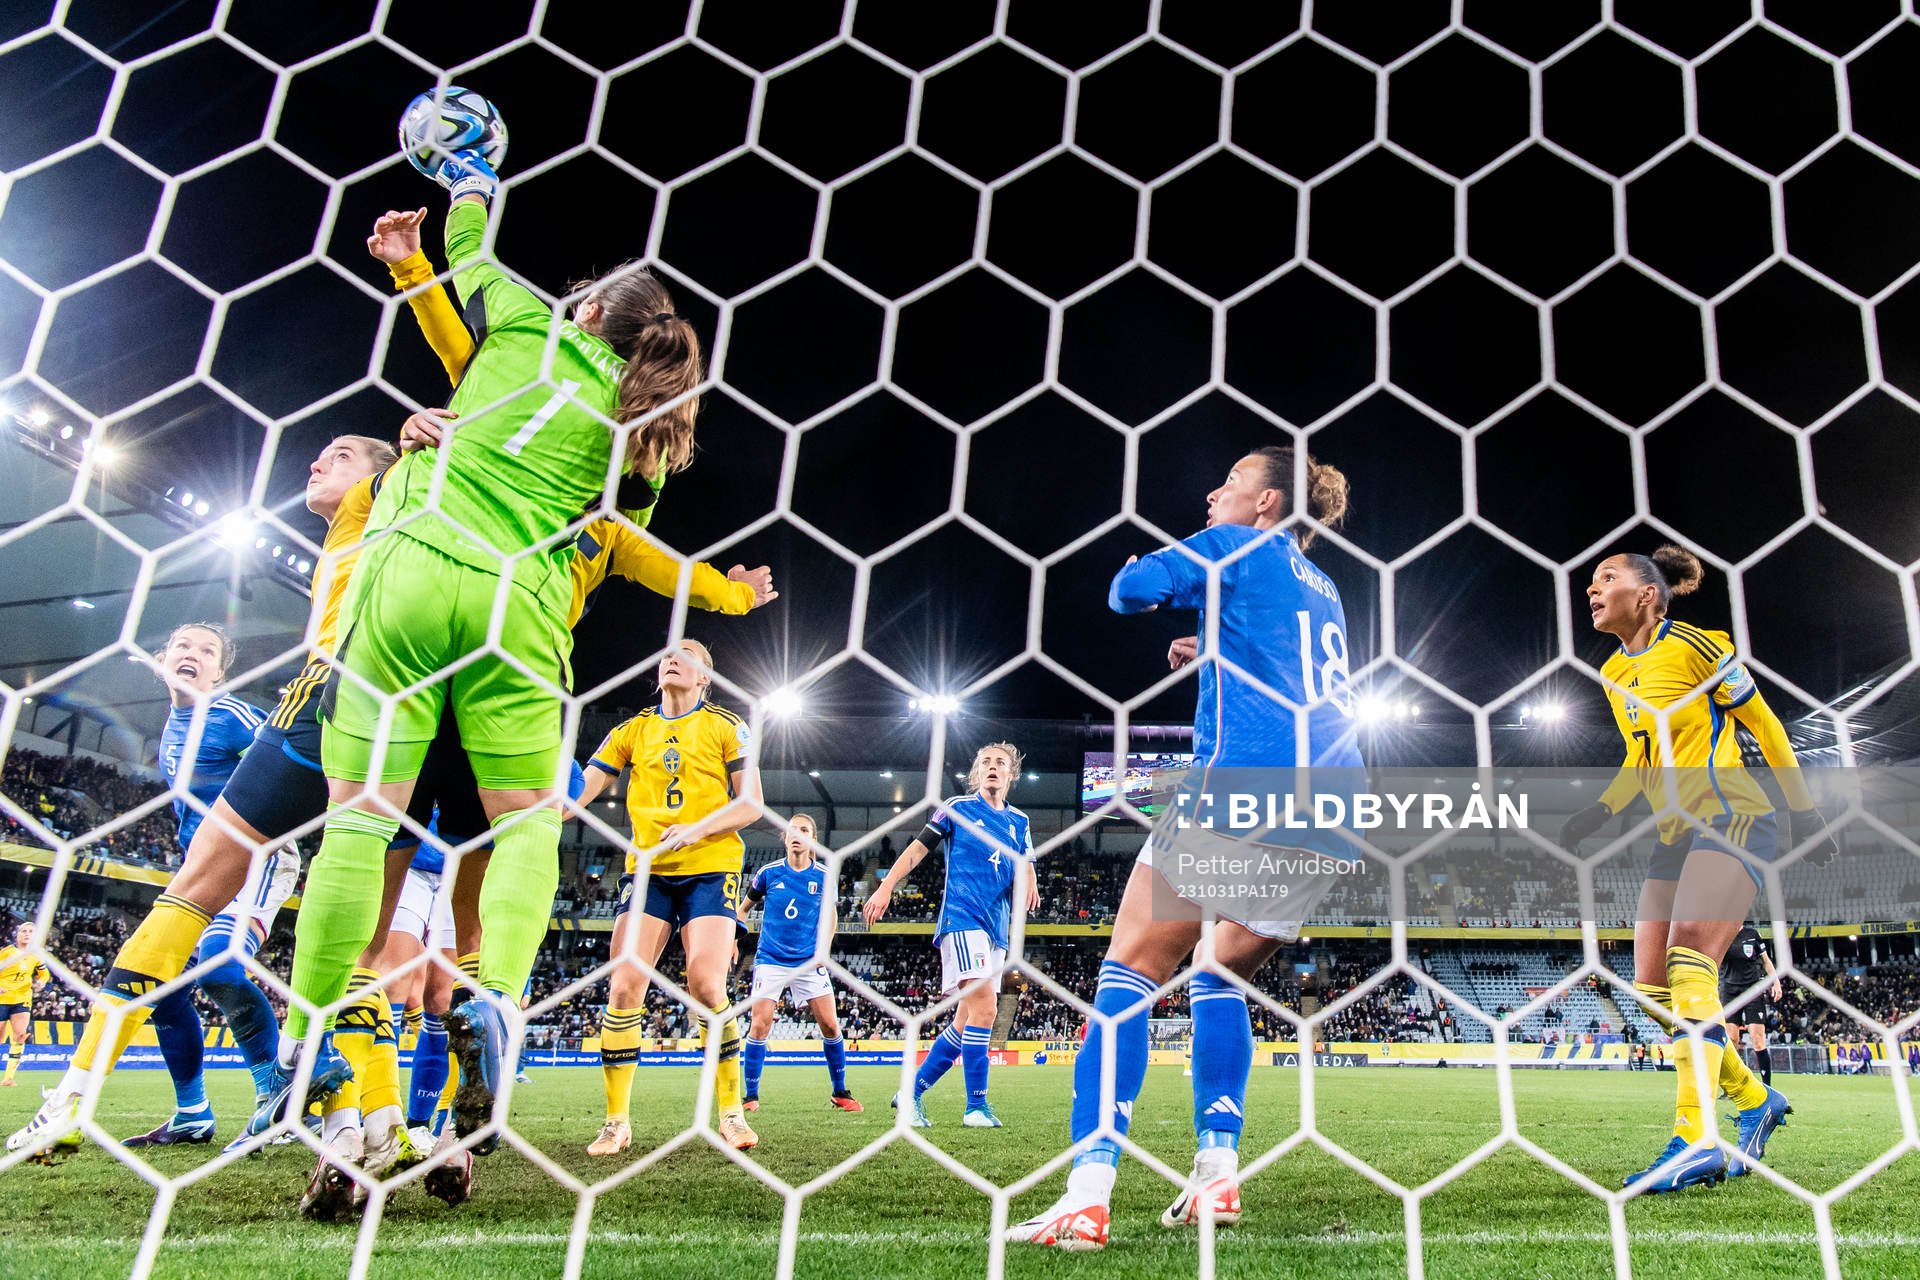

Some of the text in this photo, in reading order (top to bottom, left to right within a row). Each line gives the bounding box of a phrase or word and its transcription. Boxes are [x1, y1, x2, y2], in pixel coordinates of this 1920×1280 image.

[502, 378, 582, 457] 1
[1290, 556, 1337, 603] CARUSO
[1296, 610, 1353, 718] 18
[166, 745, 177, 776] 5
[1632, 729, 1652, 768] 7
[666, 777, 684, 809] 6
[988, 849, 1001, 876] 4
[784, 898, 799, 920] 6
[1306, 1056, 1354, 1067] LEDA
